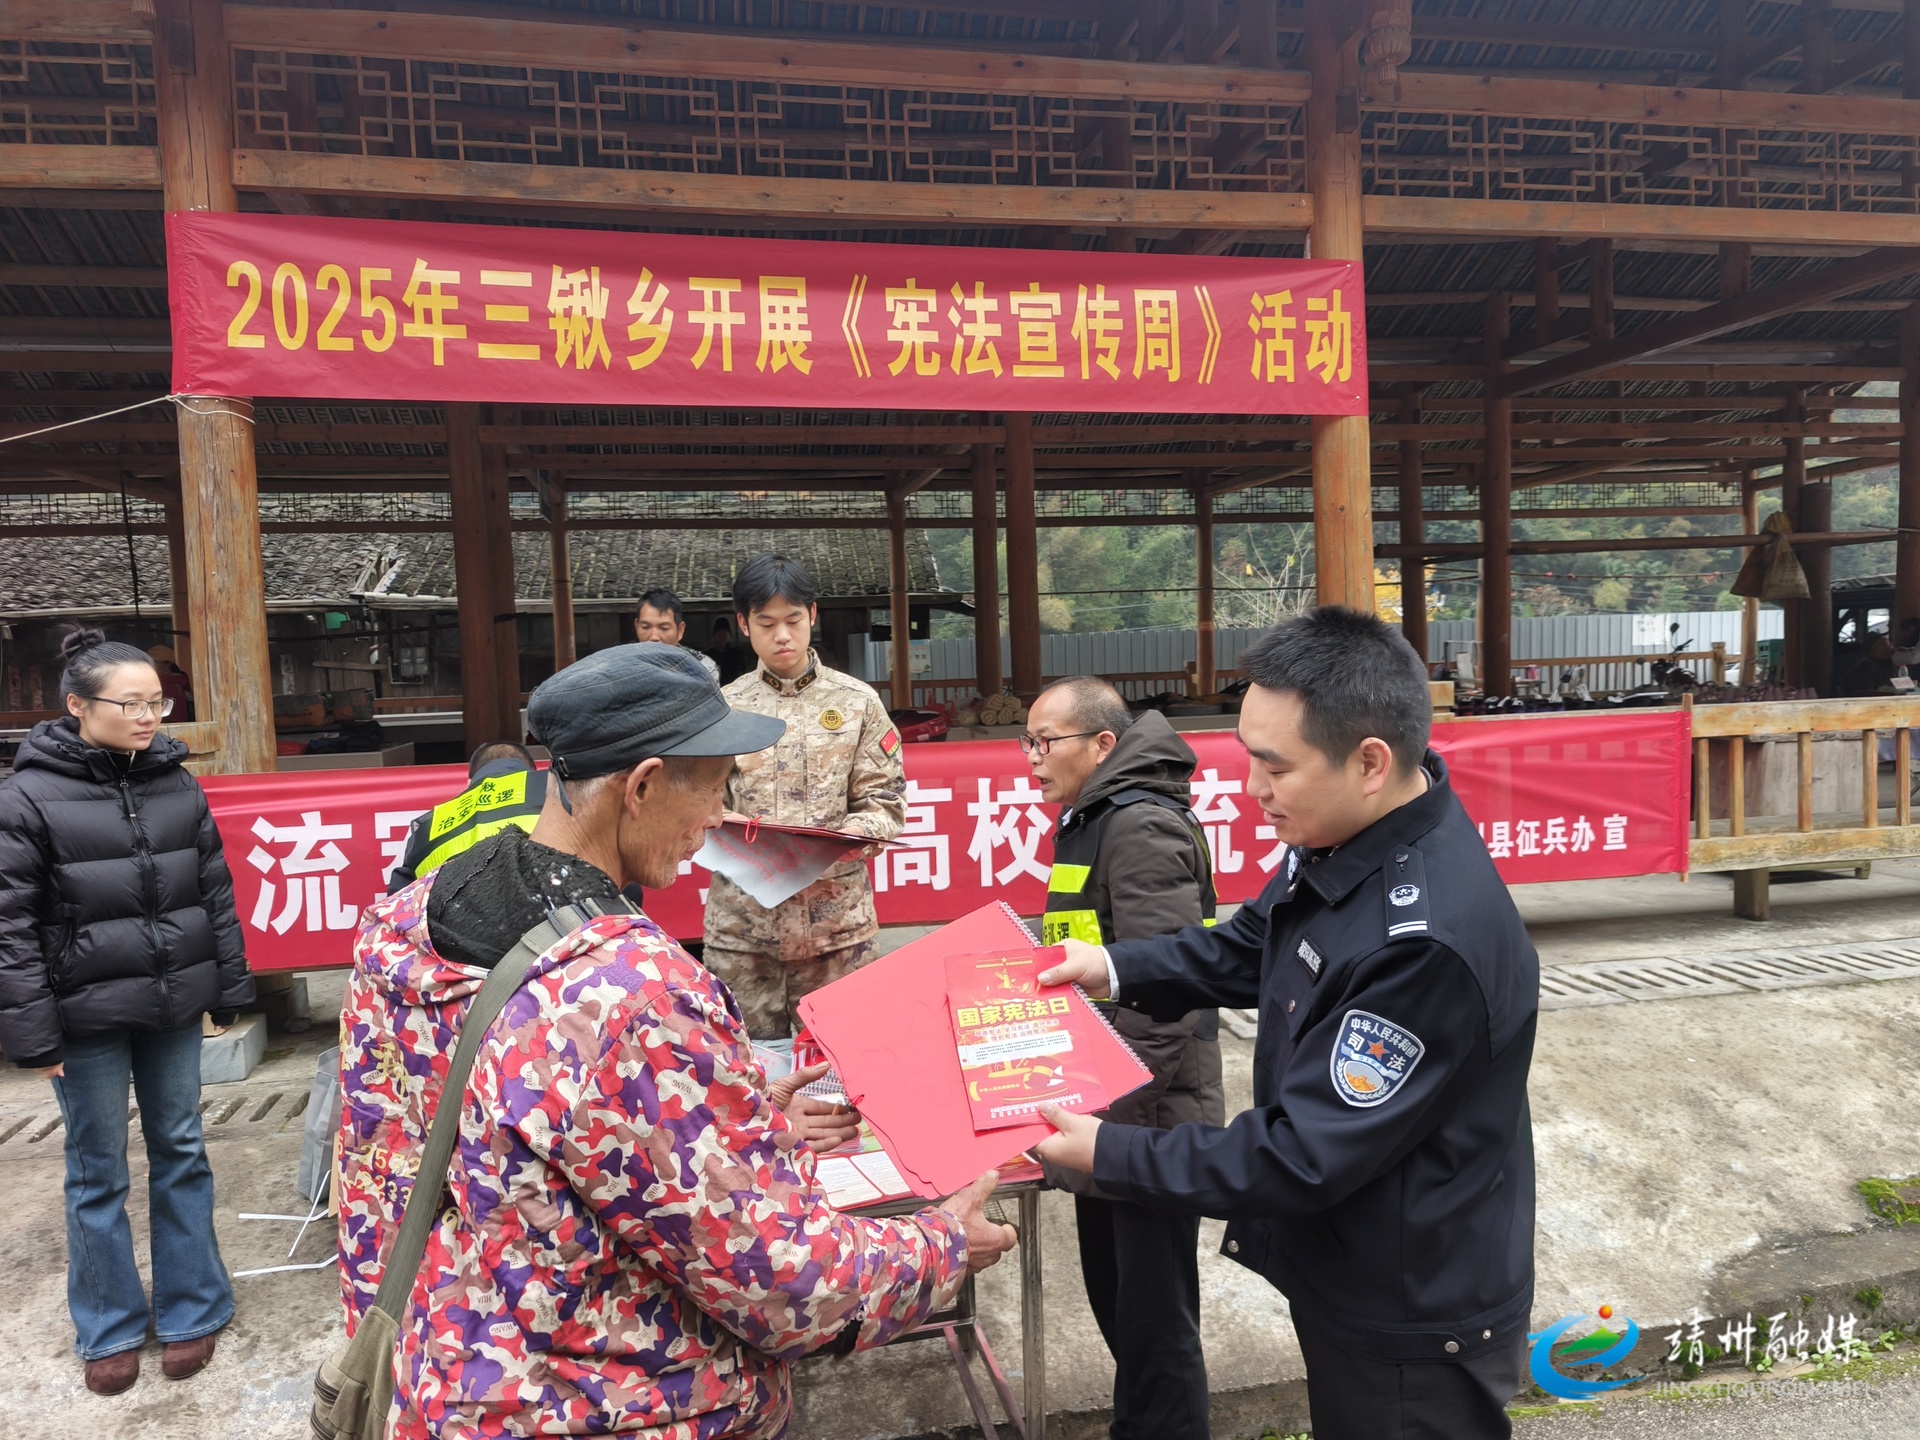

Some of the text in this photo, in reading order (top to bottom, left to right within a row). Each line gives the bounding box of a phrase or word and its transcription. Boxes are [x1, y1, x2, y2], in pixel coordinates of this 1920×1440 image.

[226, 257, 1353, 385] 2025年三锹乡开展《宪法宣传周》活动
[957, 997, 1071, 1028] 国家宪法日
[1351, 1017, 1419, 1058] 中华人民共和国
[671, 1079, 693, 1094] WANG
[476, 1295, 492, 1303] HUA
